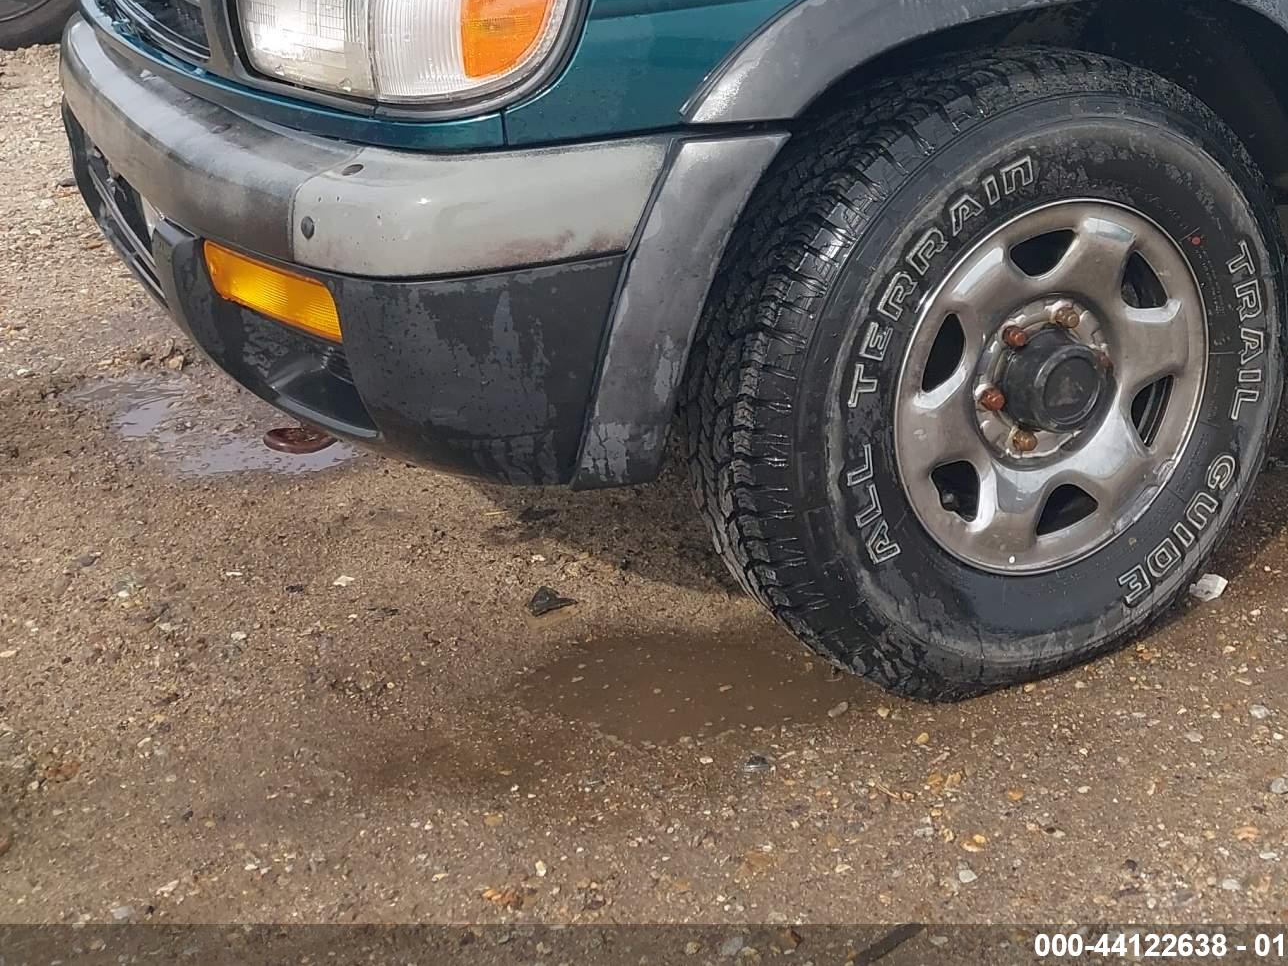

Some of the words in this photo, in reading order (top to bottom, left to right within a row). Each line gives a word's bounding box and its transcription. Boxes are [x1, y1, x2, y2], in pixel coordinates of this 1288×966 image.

[1226, 240, 1264, 421] TRAIL
[847, 443, 901, 565] ALL
[1118, 455, 1236, 604] GUIDE
